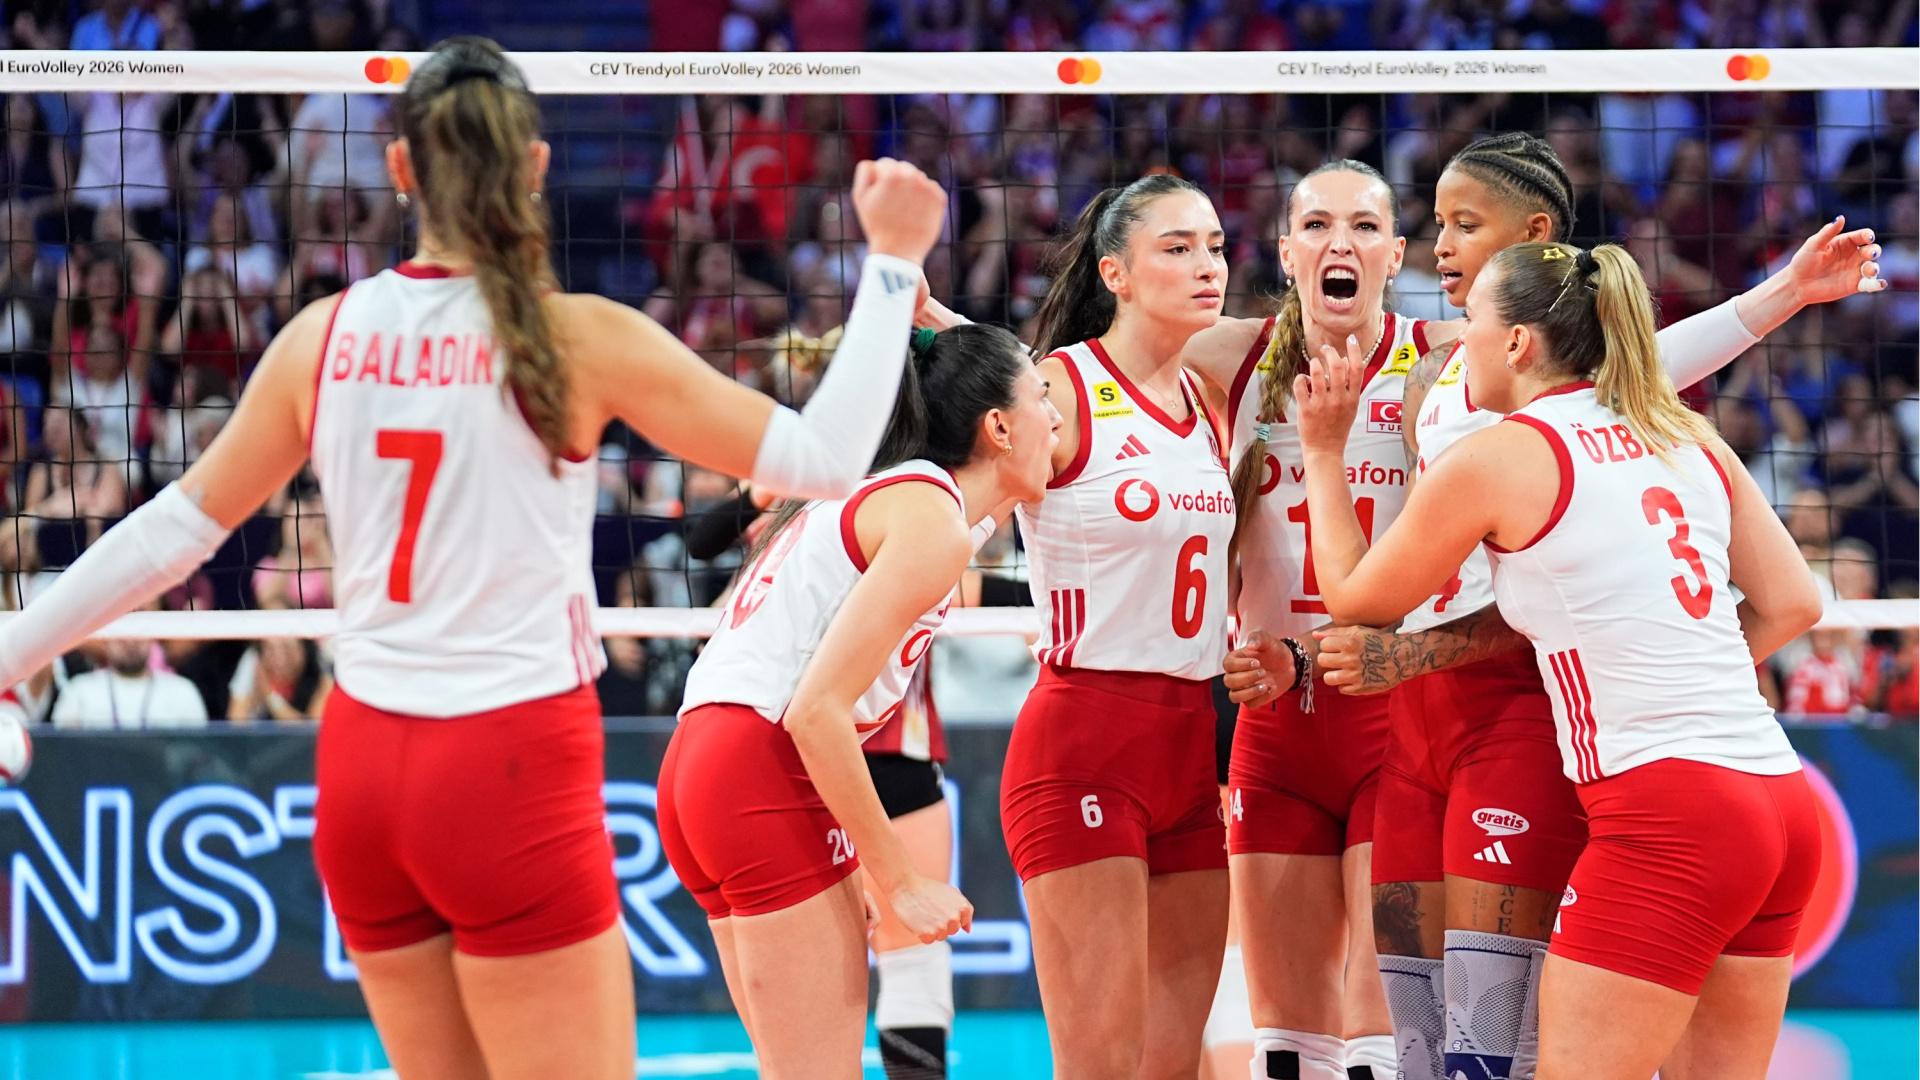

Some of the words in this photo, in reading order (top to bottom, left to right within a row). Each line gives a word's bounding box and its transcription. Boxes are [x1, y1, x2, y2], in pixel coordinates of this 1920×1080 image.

[8, 60, 85, 76] EuroVolley
[88, 60, 125, 74] 2026
[128, 60, 184, 74] Women
[589, 62, 620, 76] CEV
[622, 62, 686, 78] Trendyol
[689, 62, 765, 78] EuroVolley
[767, 62, 803, 76] 2026
[806, 62, 861, 76] Women
[1278, 61, 1307, 76] CEV
[1310, 61, 1372, 78] Trendyol
[1376, 61, 1449, 78] EuroVolley
[1453, 61, 1490, 75] 2026
[1492, 61, 1546, 75] Women
[1099, 386, 1115, 402] S
[1570, 423, 1679, 465] ÖZB
[376, 429, 445, 604] 7
[1641, 486, 1713, 620] 3
[1171, 534, 1208, 640] 6
[1080, 794, 1104, 828] 6
[1229, 788, 1244, 825] 14
[1477, 810, 1524, 831] gratis
[827, 827, 855, 866] 20
